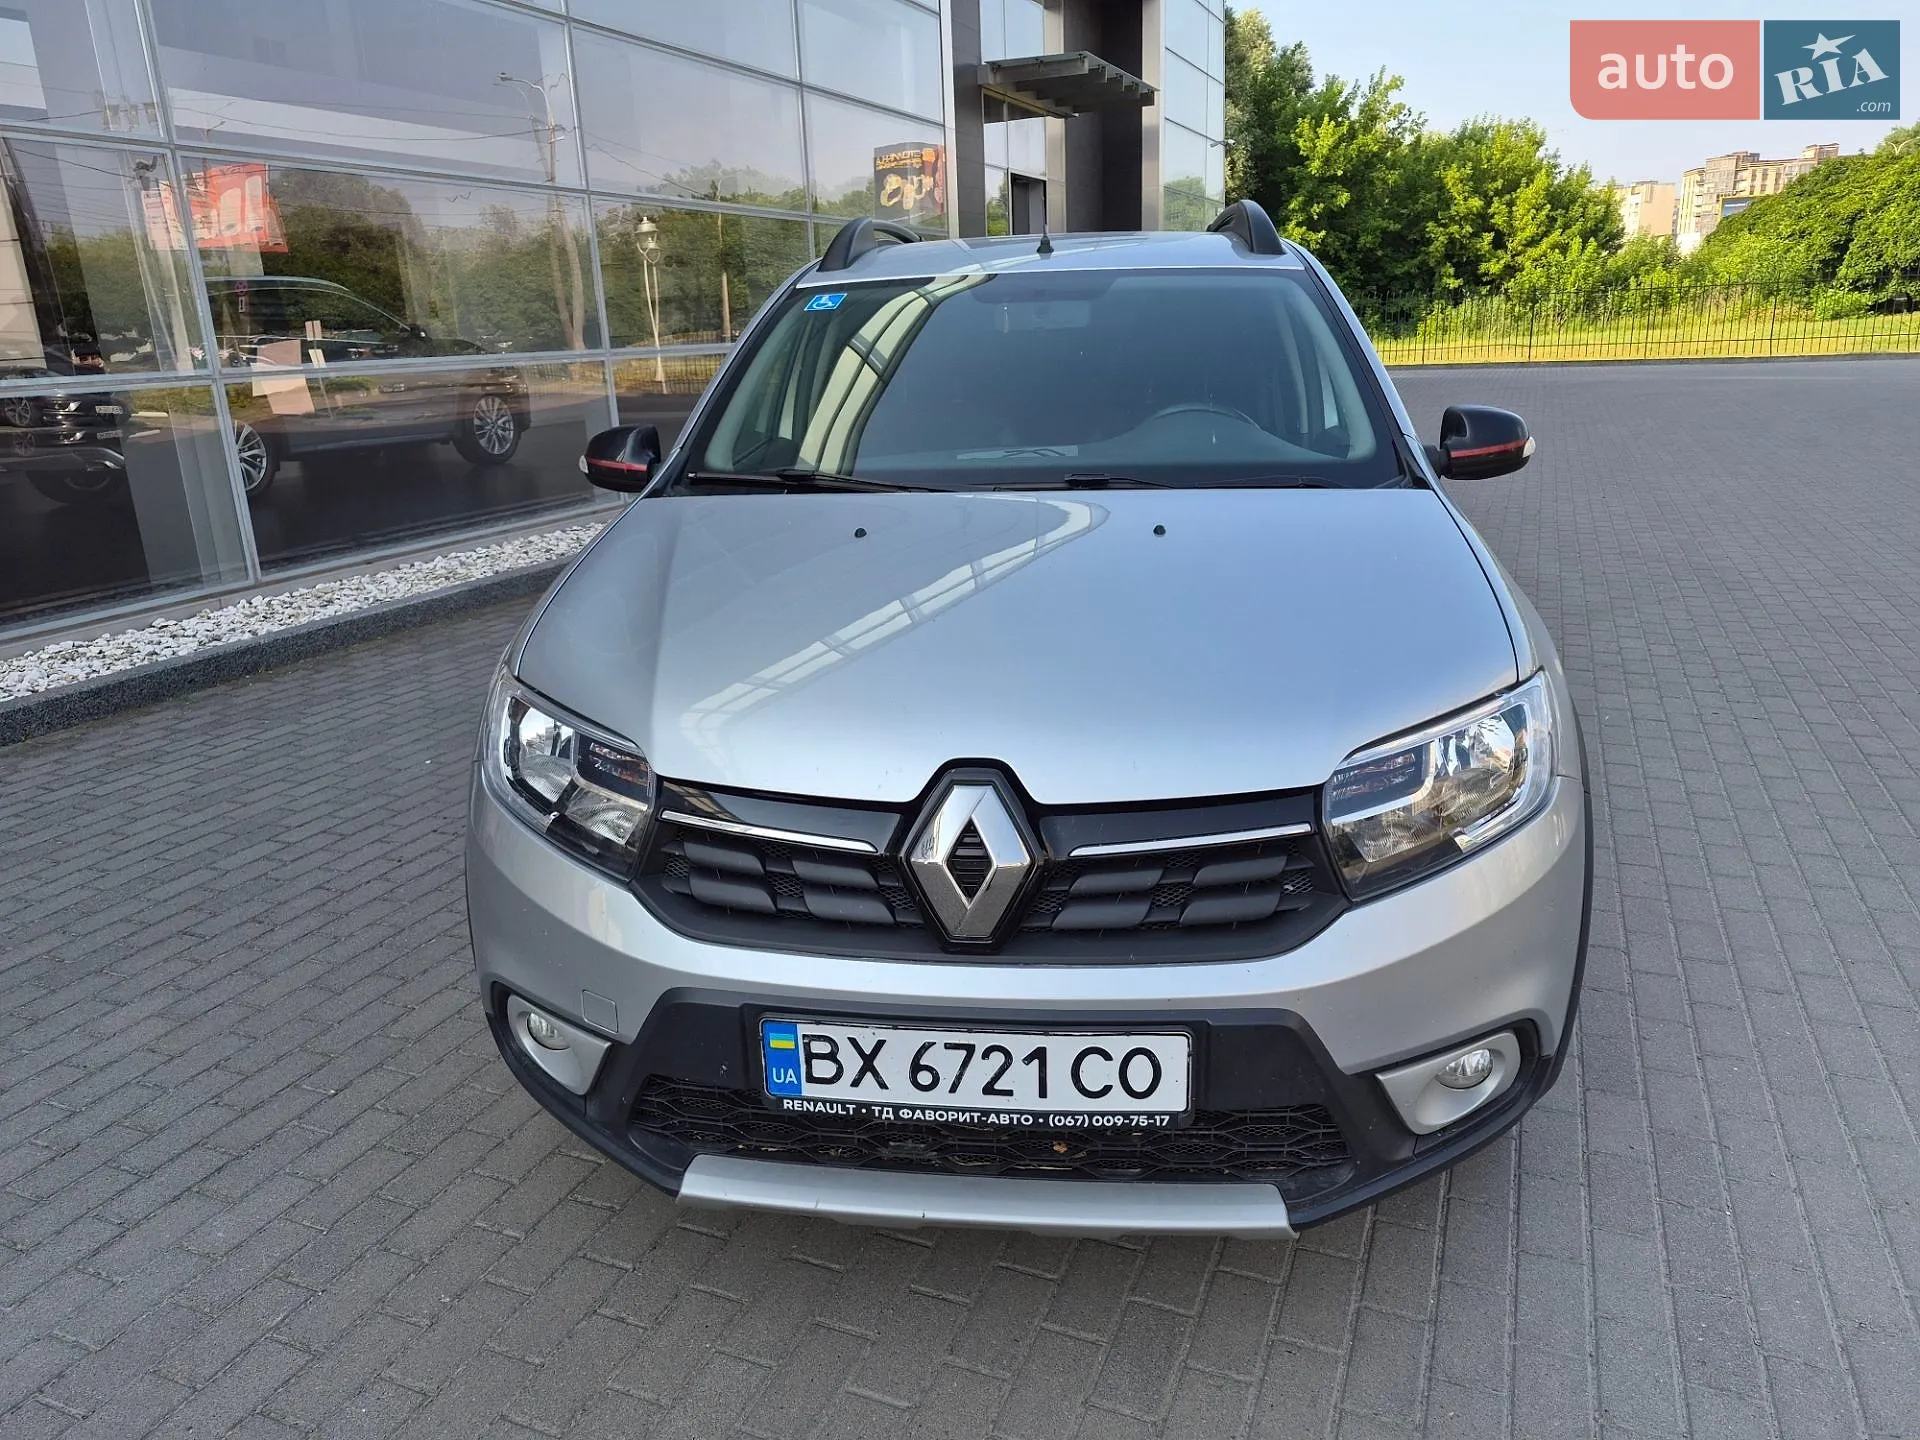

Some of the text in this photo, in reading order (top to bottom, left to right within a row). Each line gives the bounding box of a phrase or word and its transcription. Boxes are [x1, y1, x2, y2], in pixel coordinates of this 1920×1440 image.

[772, 1067, 798, 1084] UA
[802, 1033, 1162, 1100] BX 6721 CO
[783, 1099, 1171, 1127] RENAULT ТД ФАВОРИТ-АВТО (067) 009-75-17
